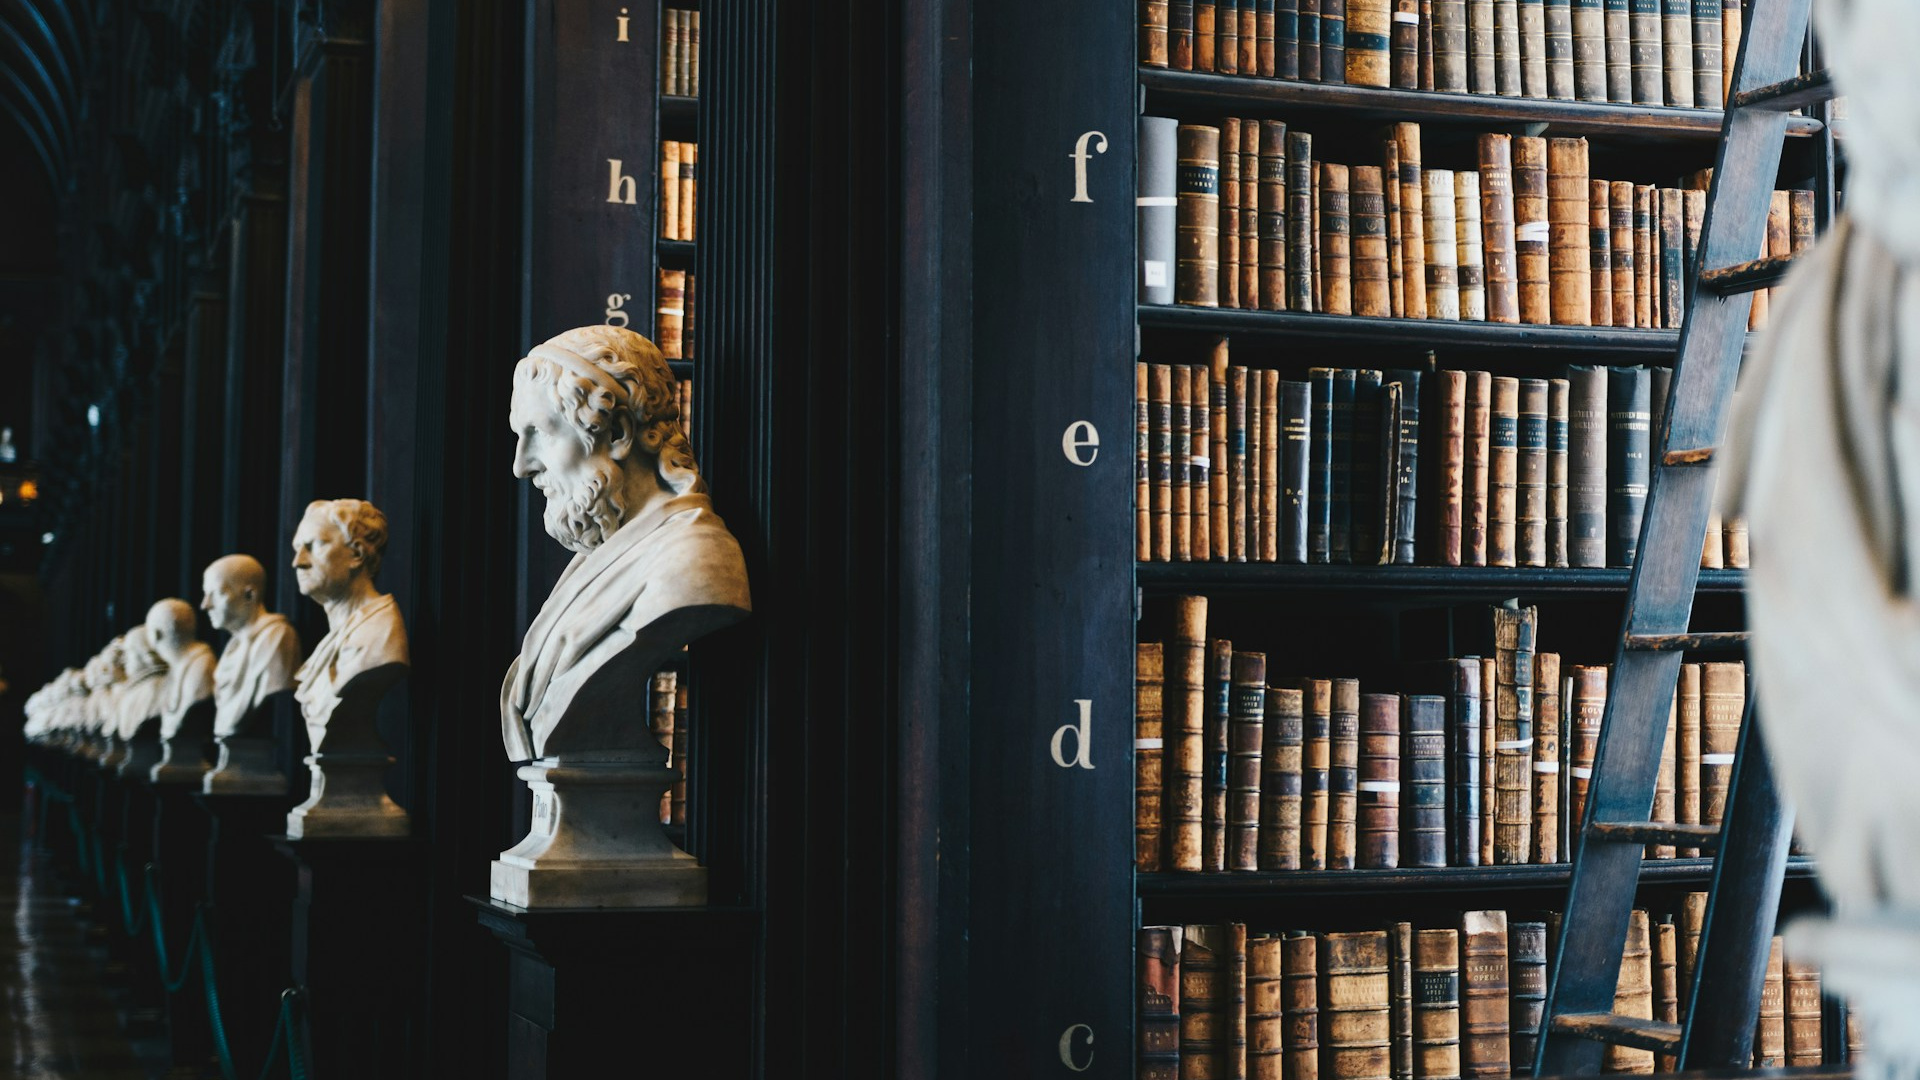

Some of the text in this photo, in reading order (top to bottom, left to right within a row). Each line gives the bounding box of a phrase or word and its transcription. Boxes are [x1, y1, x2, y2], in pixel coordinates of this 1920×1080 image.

[616, 7, 630, 42] i
[605, 158, 638, 206] h
[1067, 130, 1109, 203] f
[605, 293, 632, 328] g
[1061, 420, 1101, 467] e
[1049, 699, 1096, 770] d
[1577, 717, 1601, 725] BIBL
[535, 794, 548, 818] Plato
[1473, 973, 1500, 981] OPERA
[1058, 1022, 1095, 1072] c
